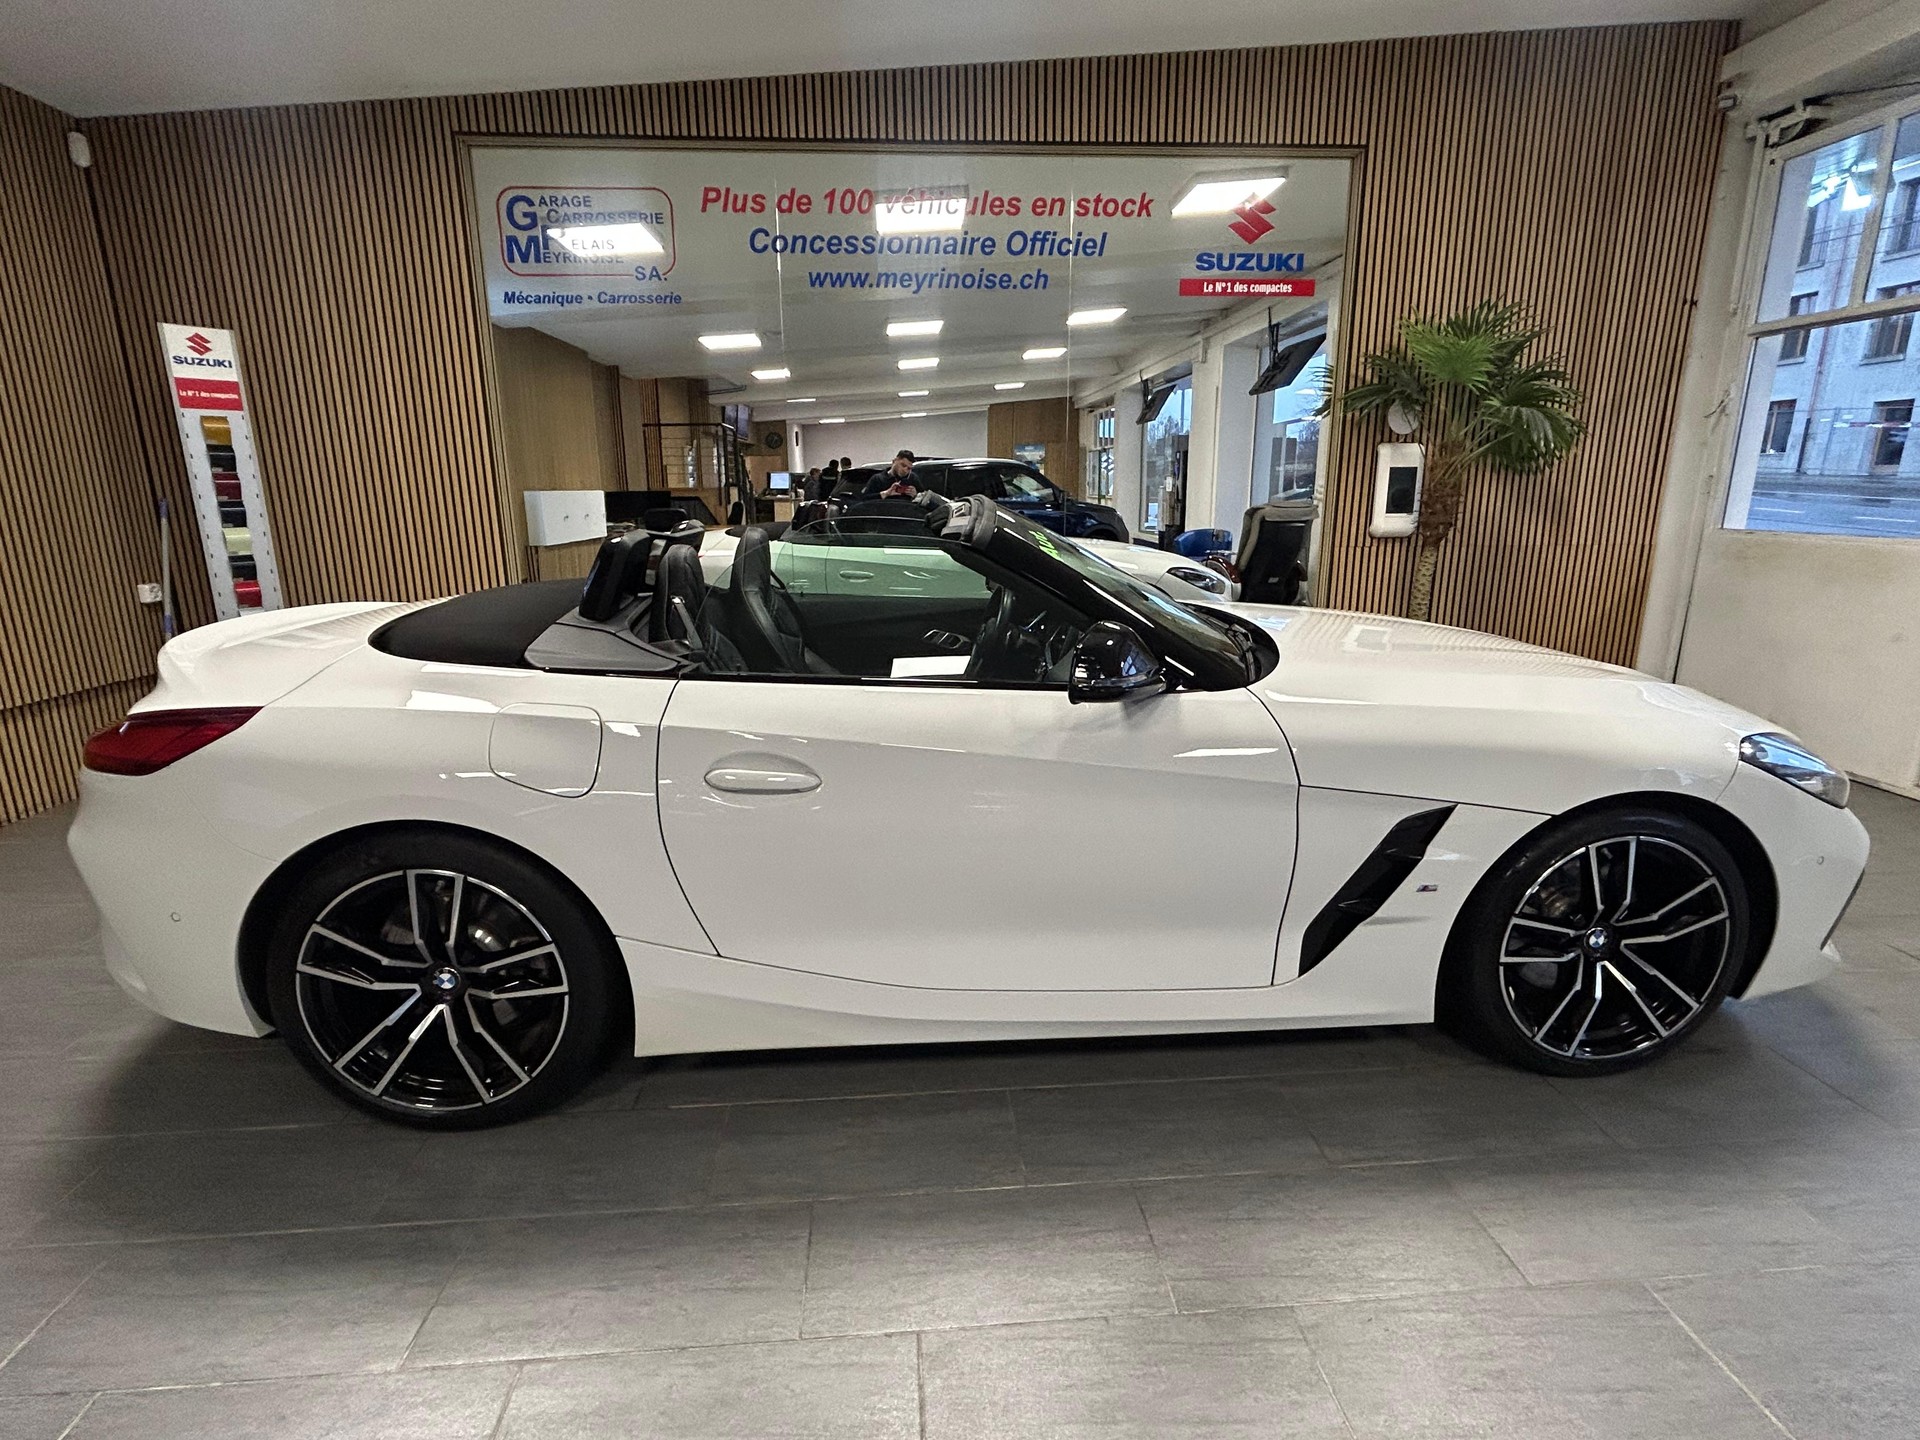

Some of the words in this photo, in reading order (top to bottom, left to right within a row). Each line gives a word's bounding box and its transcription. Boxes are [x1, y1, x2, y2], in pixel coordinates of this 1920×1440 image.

[701, 187, 766, 214] Plus
[776, 188, 812, 214] de
[824, 188, 875, 214] 100
[884, 188, 1021, 216] véhicules
[1031, 197, 1066, 216] en
[1074, 192, 1155, 217] stock
[546, 208, 665, 225] CARROSSERIE
[749, 228, 996, 256] Concessionnaire
[1006, 231, 1108, 257] Officiel
[1195, 252, 1304, 272] SUZUKI
[634, 266, 668, 281] SA.
[808, 268, 1049, 294] www.meyrinoise.ch
[1203, 282, 1213, 293] Le
[1233, 282, 1248, 293] des
[1250, 283, 1293, 295] compactes
[503, 291, 583, 307] Mécanique
[597, 291, 682, 305] Carrosserie
[172, 355, 232, 368] SUZUKI
